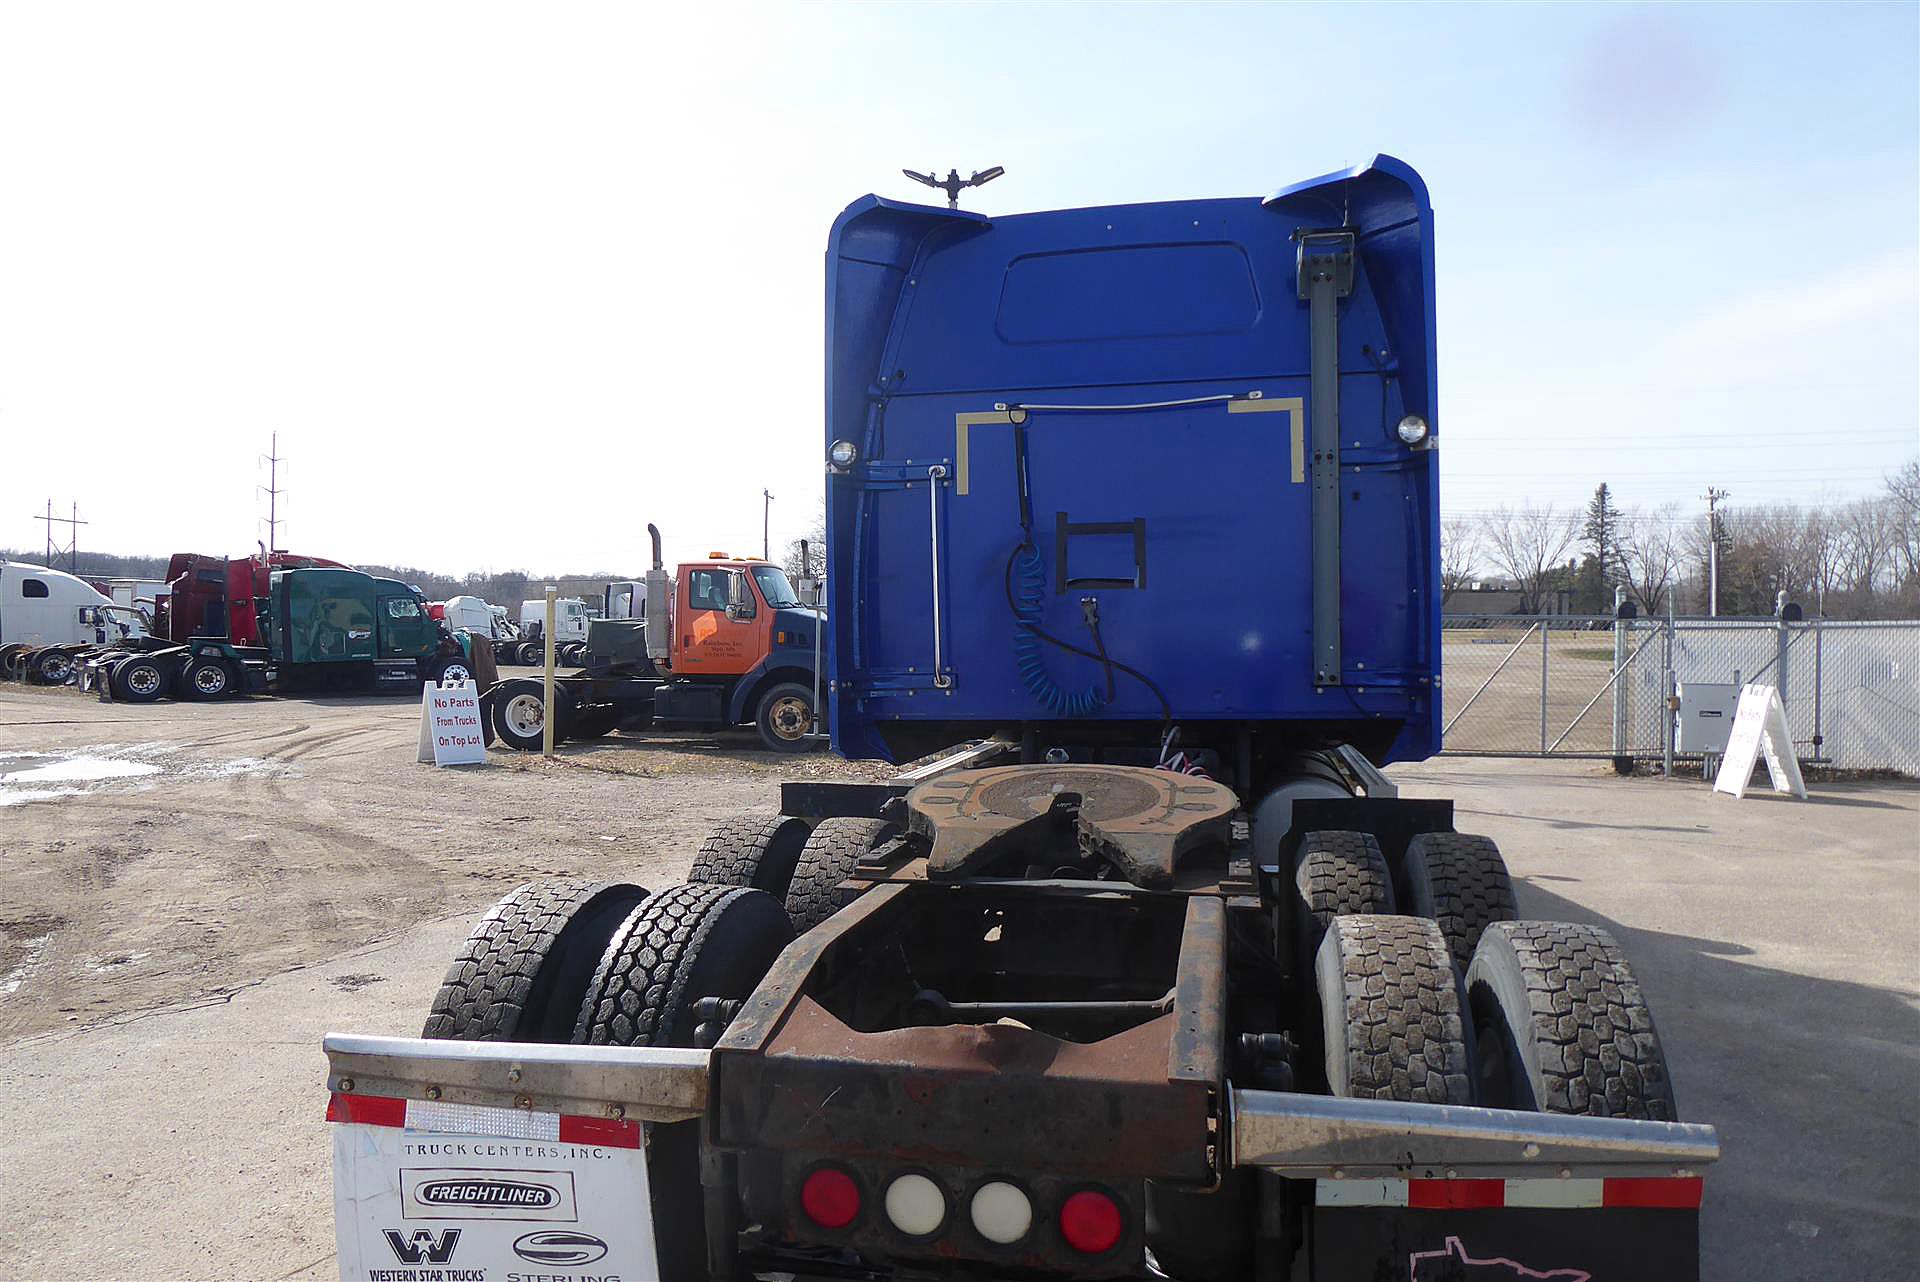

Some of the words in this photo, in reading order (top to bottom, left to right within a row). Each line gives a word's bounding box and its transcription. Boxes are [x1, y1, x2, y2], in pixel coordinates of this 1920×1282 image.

[434, 698, 447, 708] No
[450, 698, 474, 708] Parts
[436, 717, 453, 726] From
[454, 715, 477, 725] Trucks
[439, 736, 449, 746] On
[451, 736, 466, 747] Top
[467, 735, 480, 745] Lot
[405, 1144, 469, 1155] TRUCK
[570, 1147, 612, 1159] INC.
[428, 1185, 546, 1204] FREIGHTLINER
[369, 1269, 417, 1282] WESTERN
[419, 1270, 443, 1282] STAR
[445, 1269, 485, 1282] TRUCKS
